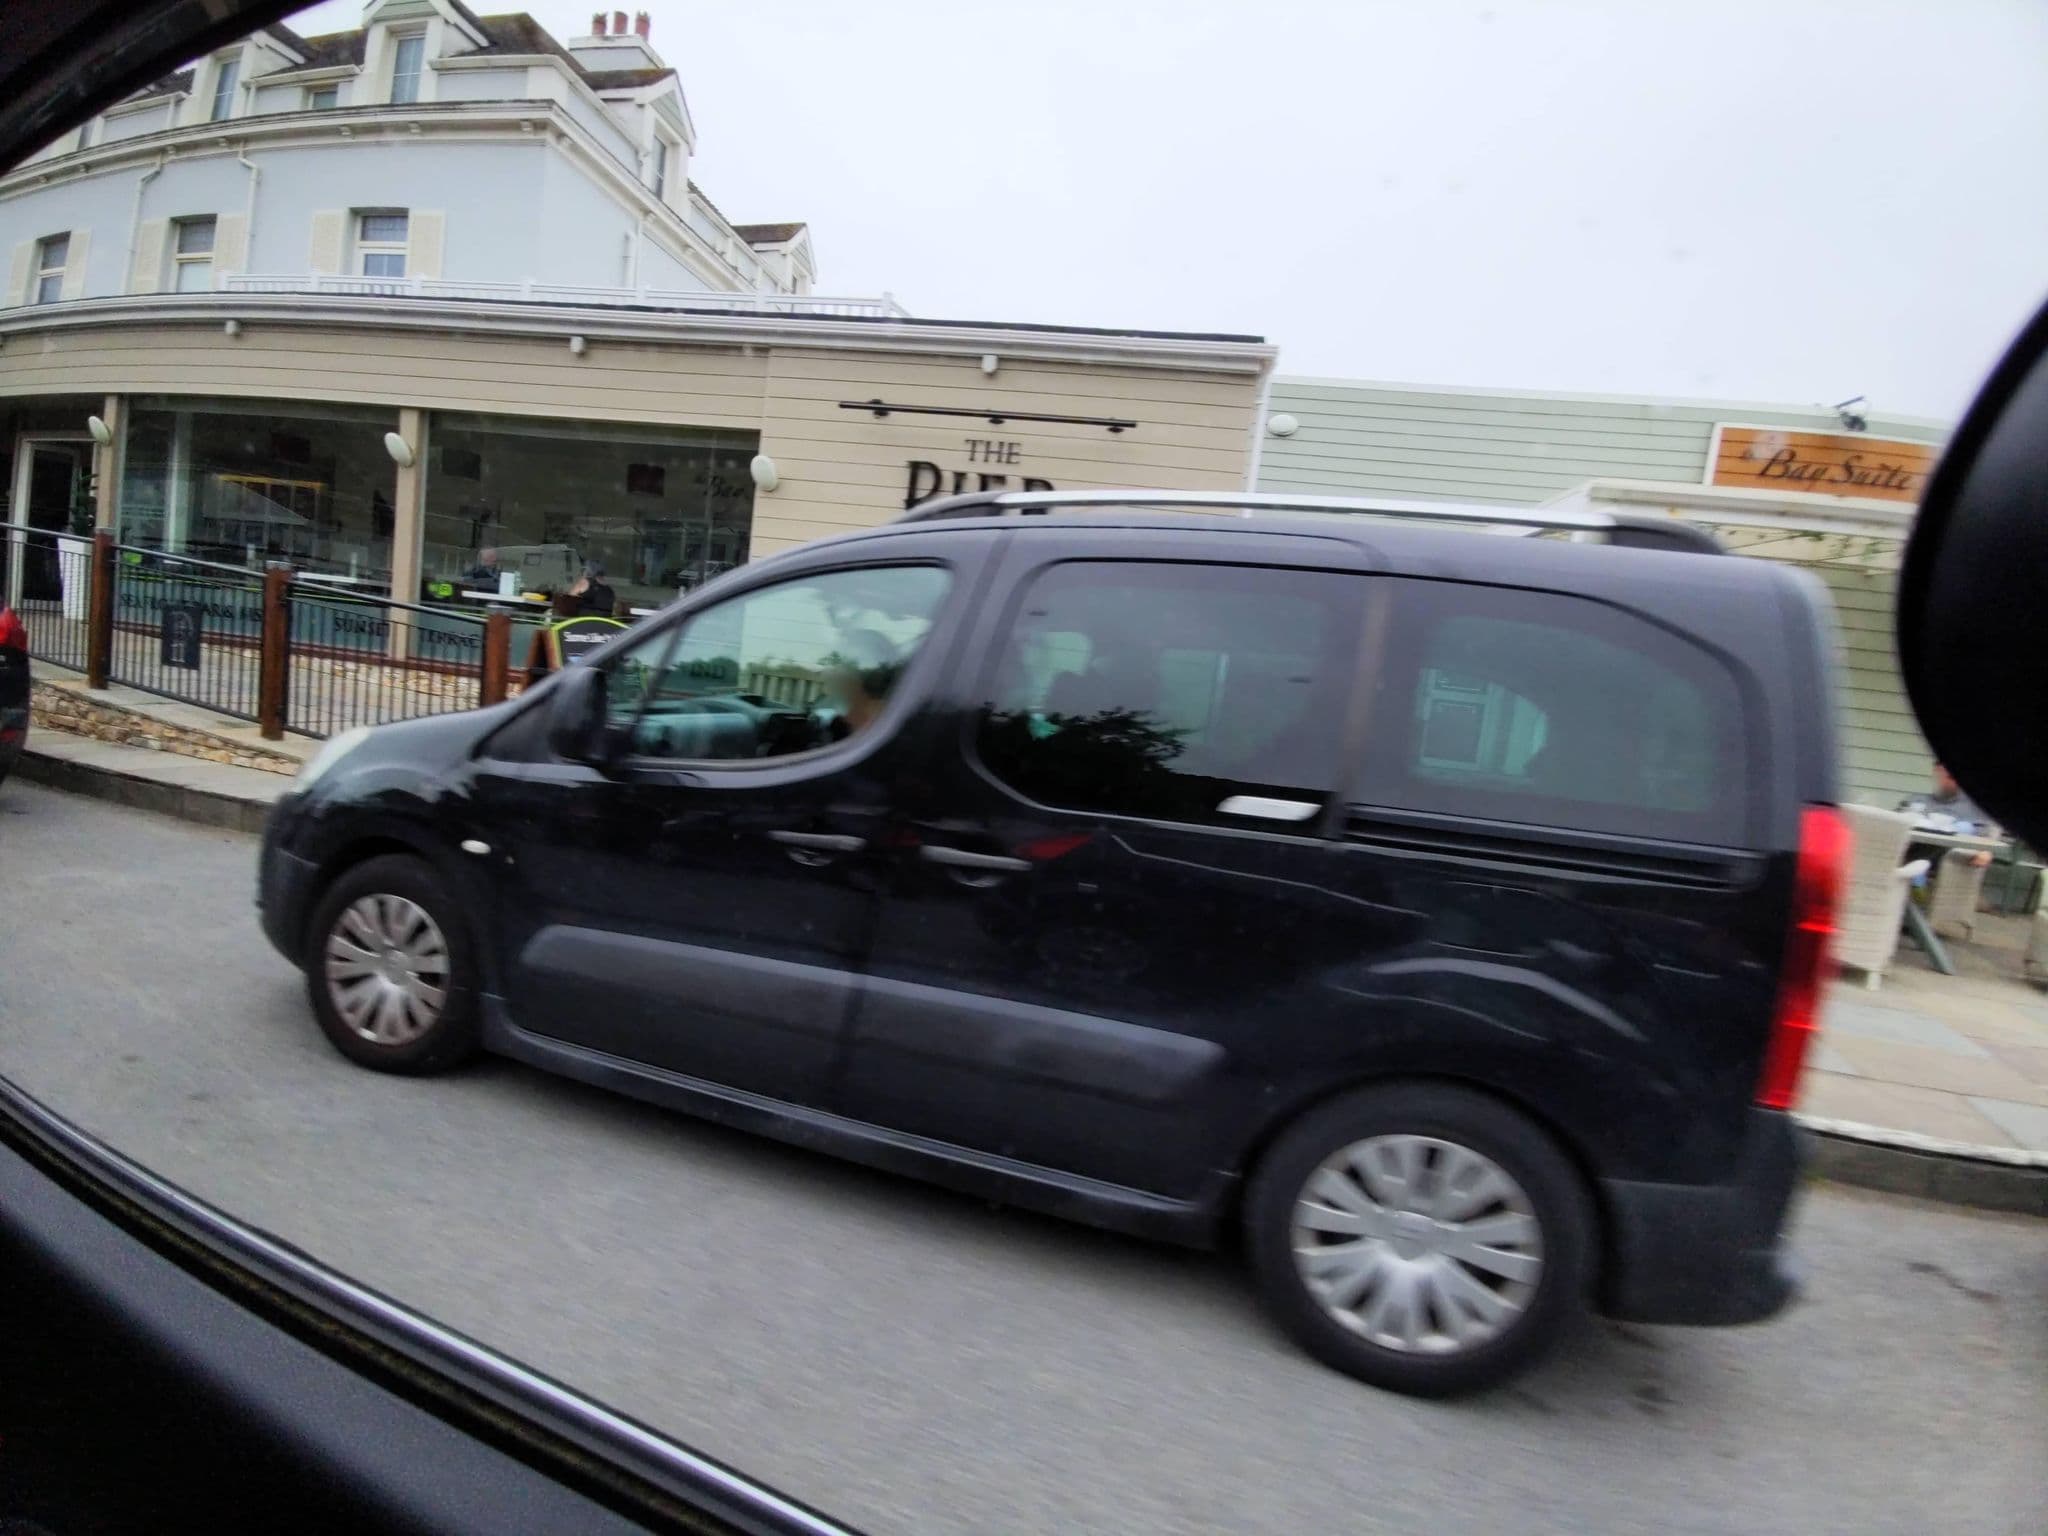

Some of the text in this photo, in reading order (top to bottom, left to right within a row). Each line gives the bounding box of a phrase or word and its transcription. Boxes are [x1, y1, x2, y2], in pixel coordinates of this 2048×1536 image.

[965, 439, 1022, 464] THE
[1745, 447, 1913, 491] Bay Suite
[421, 628, 482, 649] TERRAC
